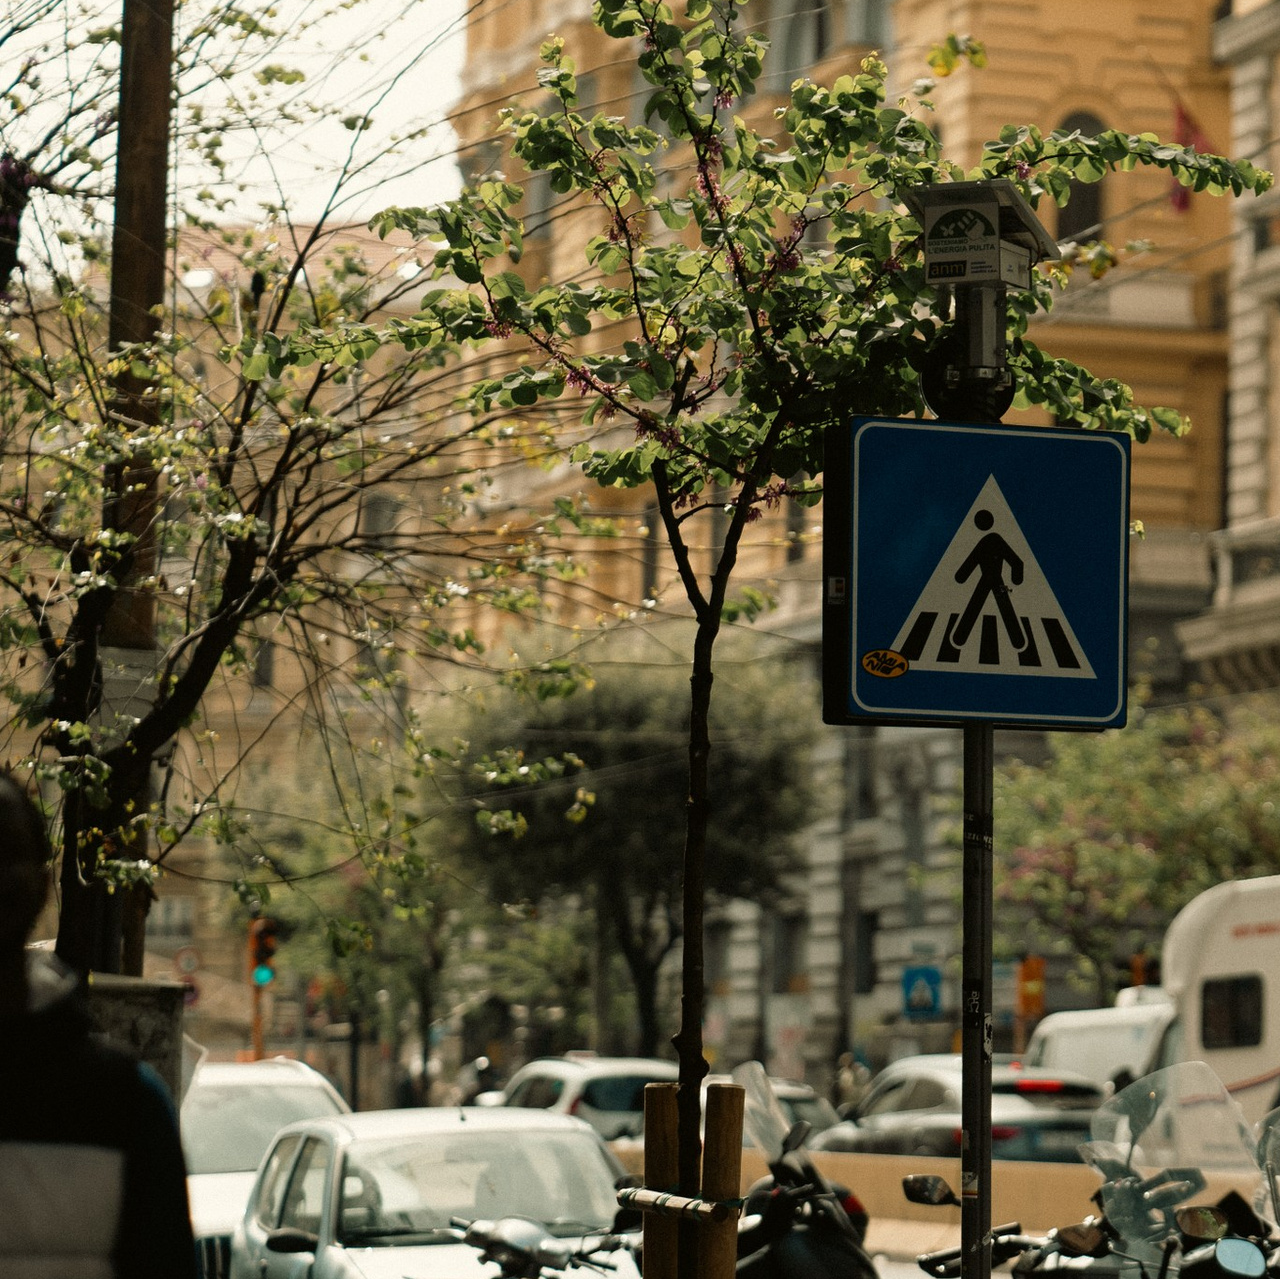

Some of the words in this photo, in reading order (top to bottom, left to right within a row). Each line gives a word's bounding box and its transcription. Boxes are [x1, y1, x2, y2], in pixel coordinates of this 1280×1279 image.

[928, 245, 967, 254] L'ENERGIA
[969, 243, 996, 251] PULITA
[931, 264, 965, 276] anm
